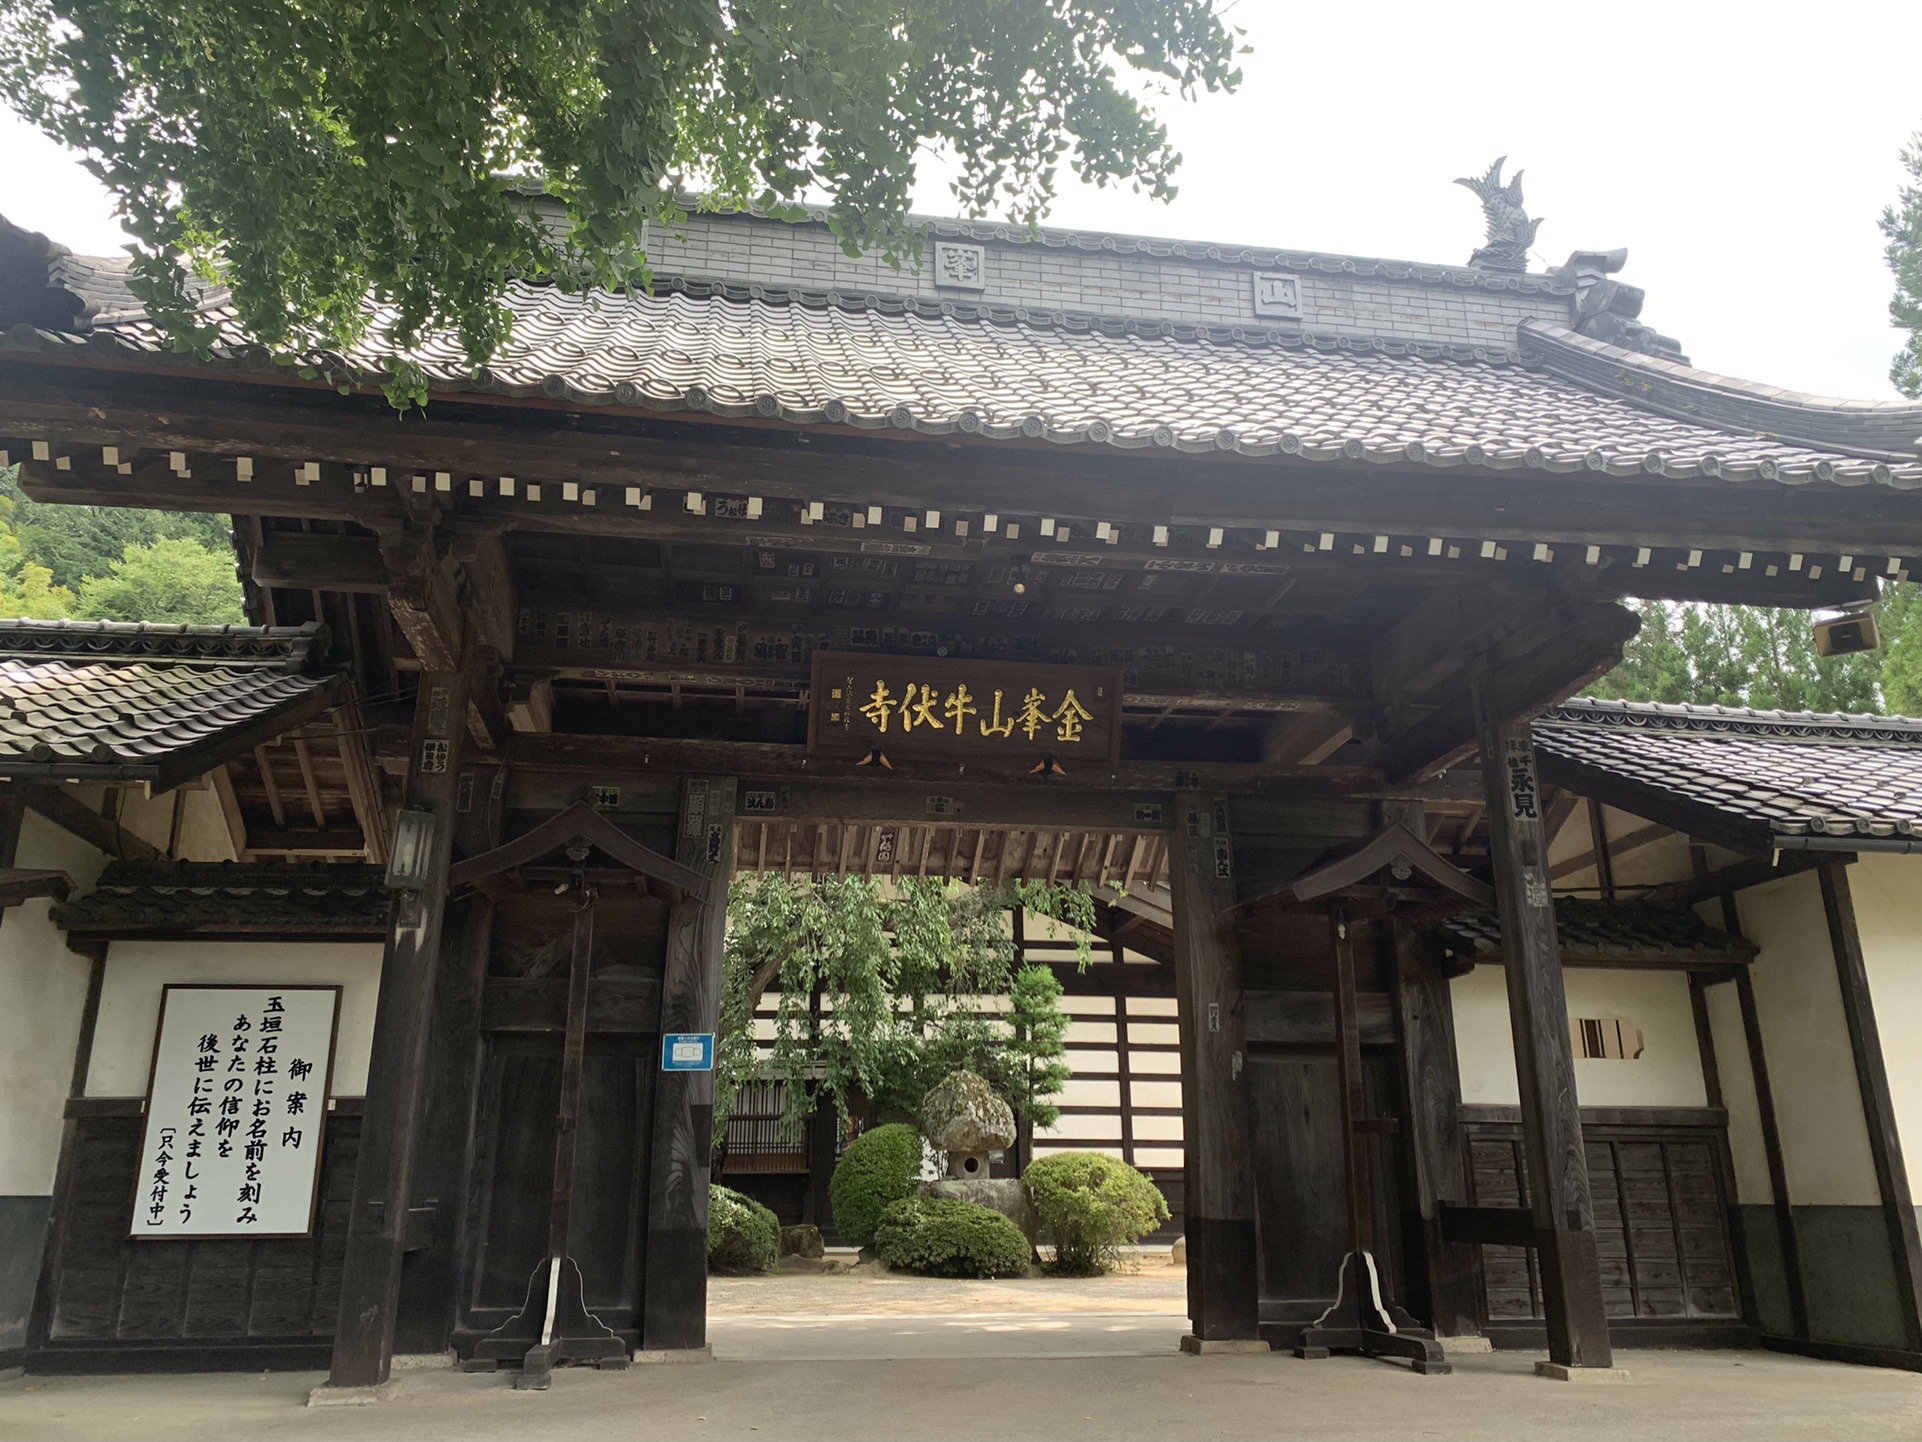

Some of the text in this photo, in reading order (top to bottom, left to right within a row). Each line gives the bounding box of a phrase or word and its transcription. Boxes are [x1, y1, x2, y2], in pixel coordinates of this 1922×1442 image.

[1261, 280, 1297, 307] 山
[179, 1033, 221, 1224] 後世に伝えましょう
[214, 1013, 252, 1158] あなたの信仰を
[236, 995, 286, 1223] 玉垣石柱にお名前を刻み
[282, 1058, 312, 1149] 御案内
